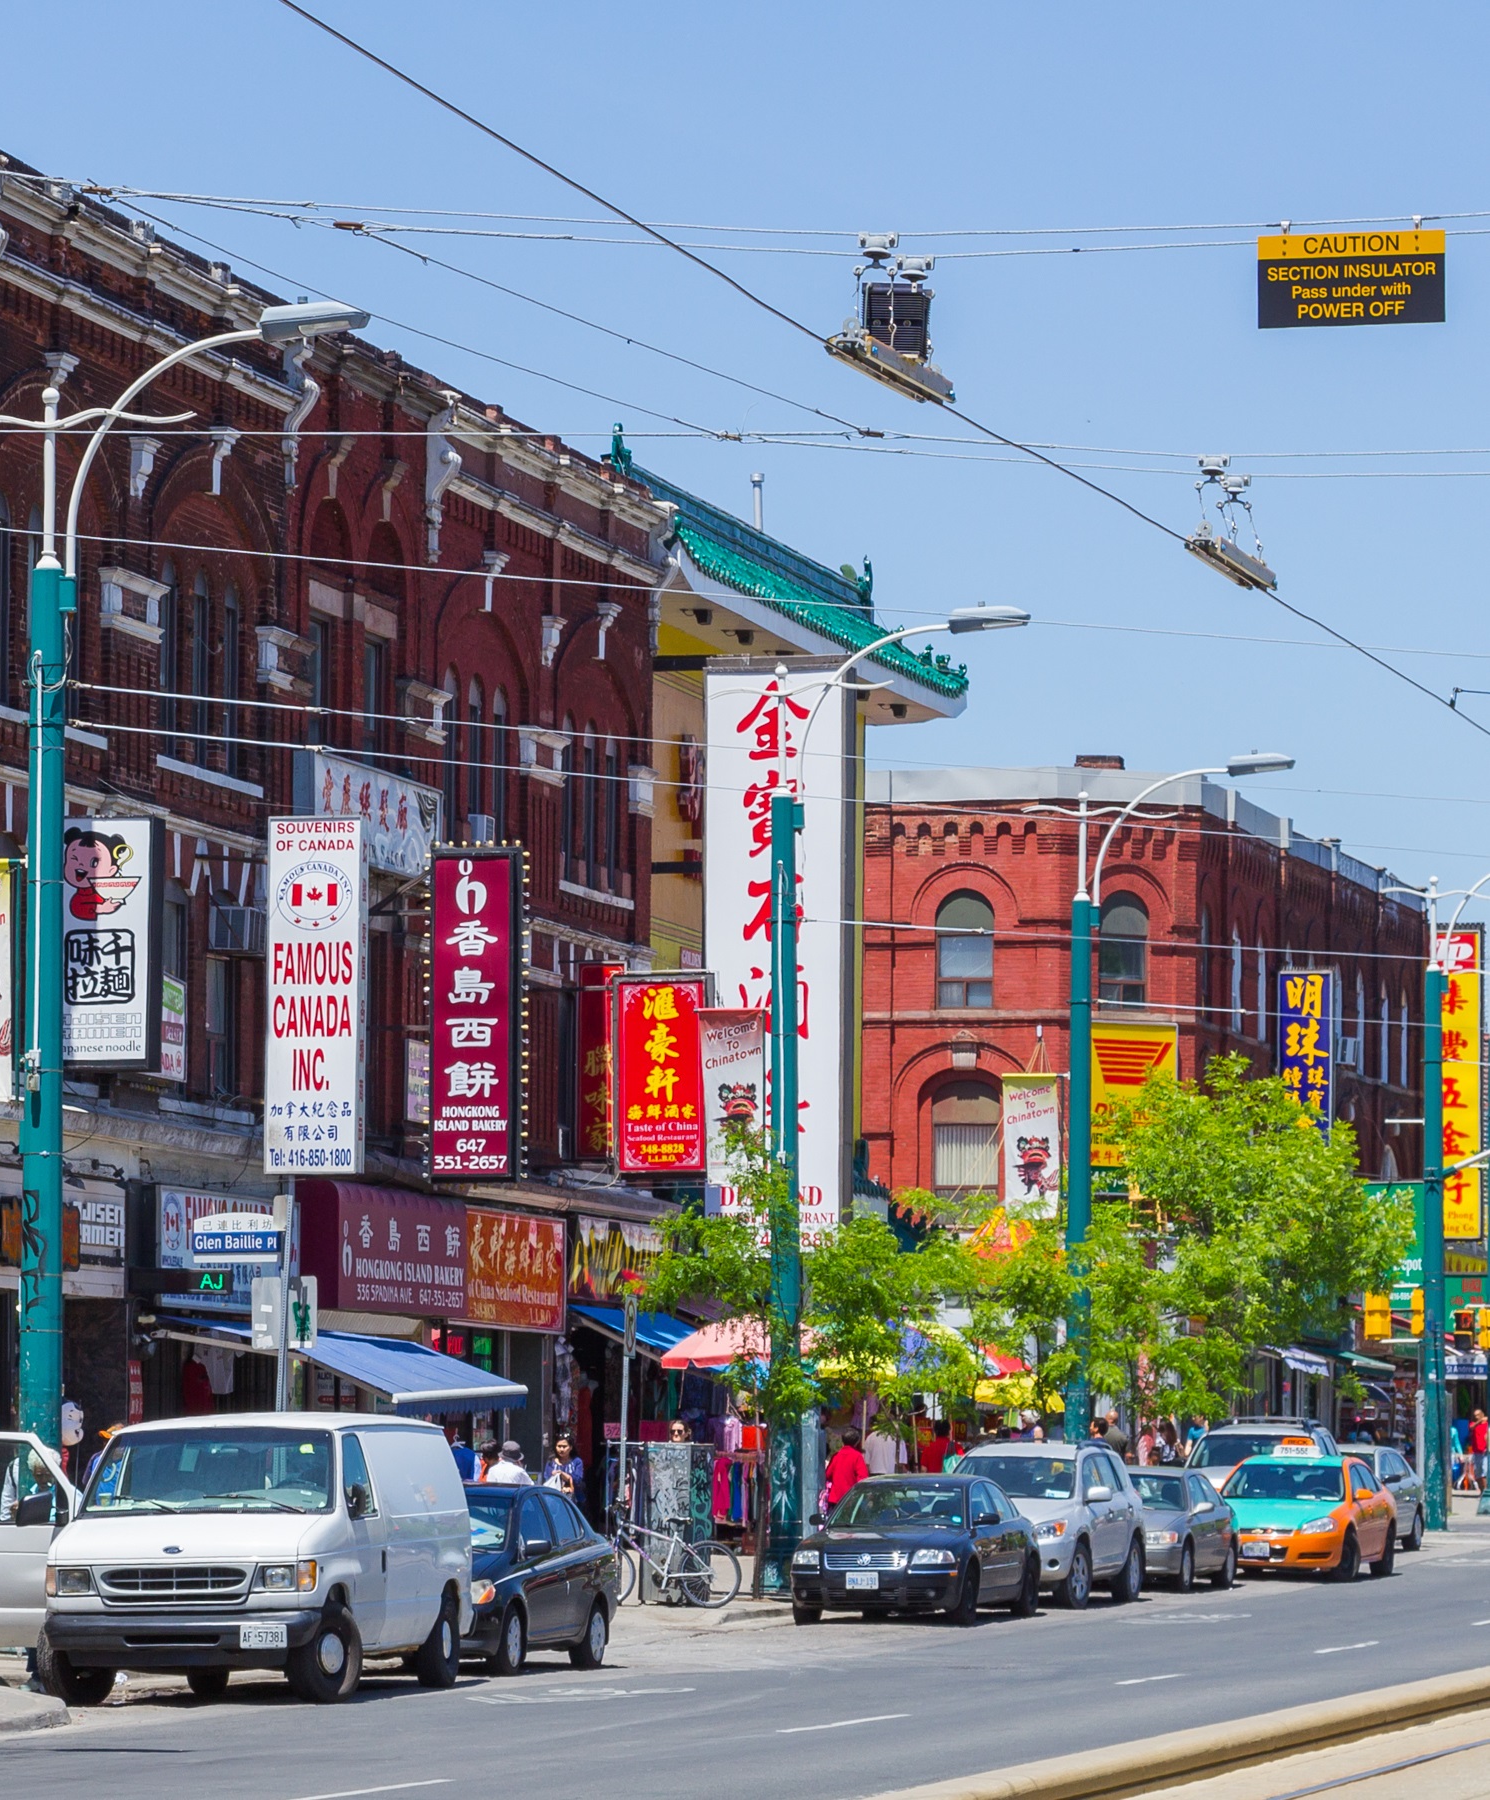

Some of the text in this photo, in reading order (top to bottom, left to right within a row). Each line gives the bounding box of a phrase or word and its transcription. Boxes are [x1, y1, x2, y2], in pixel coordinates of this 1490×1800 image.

[1303, 234, 1399, 255] CAUTION
[1267, 262, 1436, 281] SECTION INSULATOR
[1292, 282, 1411, 299] Pass under with
[1298, 301, 1405, 319] POWER OFF
[277, 820, 355, 835] SOUVENIRS
[276, 838, 355, 851] OF CANADA
[278, 862, 339, 901] FAMOUS CANADA
[273, 940, 353, 986] FAMOUS
[273, 994, 352, 1039] CANADA
[443, 919, 499, 1099] 香島西餅
[707, 1021, 757, 1042] Welcome
[106, 1041, 141, 1052] noodle
[727, 1040, 739, 1051] To
[705, 1047, 761, 1069] Chinatown
[292, 1048, 330, 1091] INC.
[1009, 1085, 1051, 1101] Welcome
[269, 1100, 352, 1118] 加拿大紀念品
[441, 1105, 500, 1119] HONGKONG
[1025, 1101, 1035, 1109] To
[1007, 1106, 1054, 1125] Chinatown
[283, 1124, 339, 1141] 有限公司
[434, 1119, 508, 1131] ISLAND BAKERY
[626, 1122, 698, 1132] Taste of China
[456, 1138, 486, 1153] 647
[640, 1144, 684, 1154] 348-8828
[269, 1148, 352, 1167] Tel: 416-850-1800
[434, 1155, 507, 1170] 351-2657
[195, 1234, 277, 1250] Glen Baillie Pl
[359, 1214, 461, 1259] 香島西餅
[356, 1258, 464, 1287] HONGKONG ISLAND BAKERY
[200, 1274, 224, 1290] AJ
[475, 1280, 495, 1299] China
[357, 1284, 463, 1308] 336 SPADINA AVE. 647-351-2657
[242, 1631, 284, 1643] AF 57381
